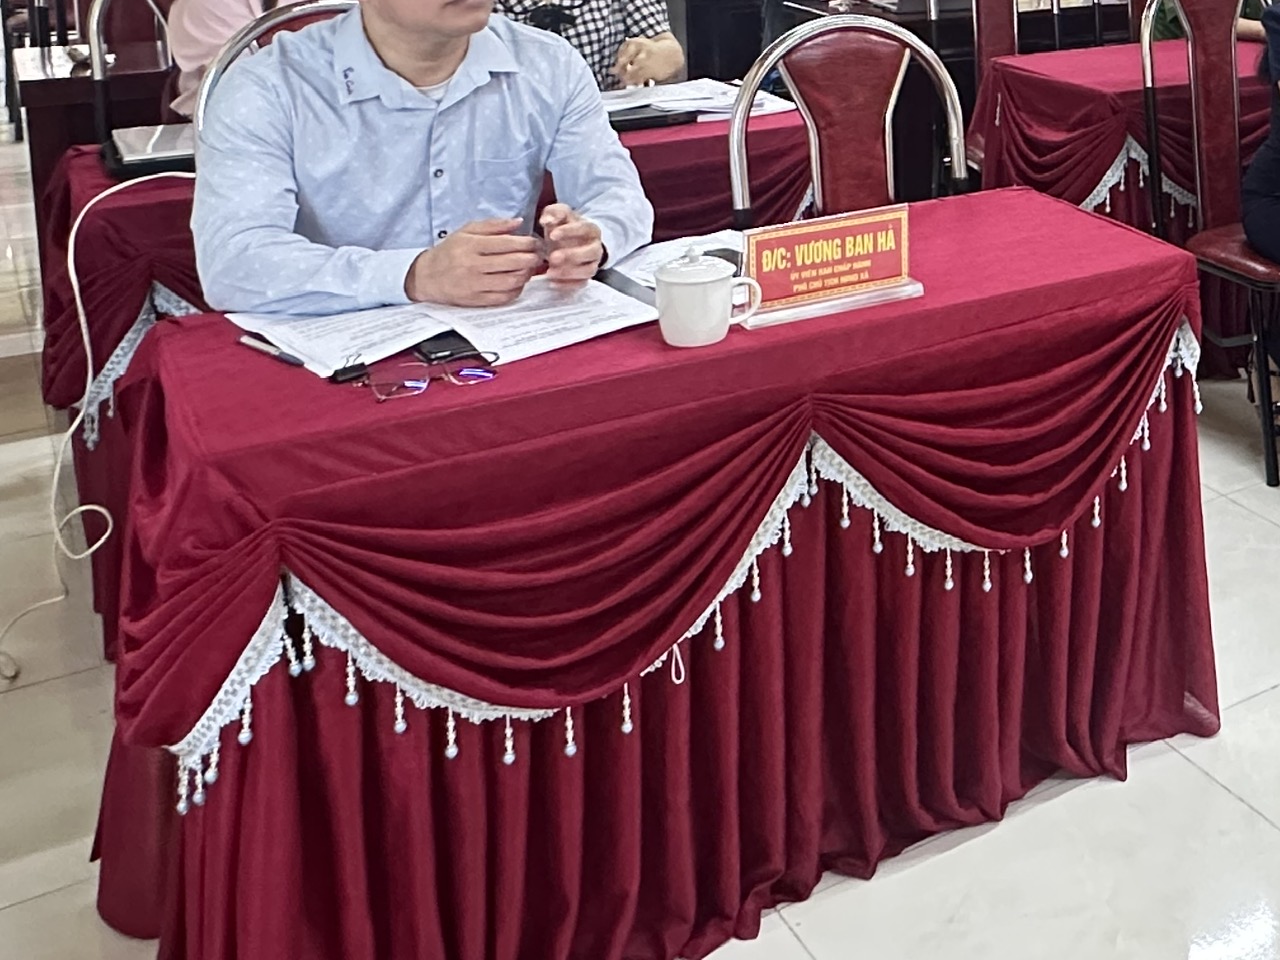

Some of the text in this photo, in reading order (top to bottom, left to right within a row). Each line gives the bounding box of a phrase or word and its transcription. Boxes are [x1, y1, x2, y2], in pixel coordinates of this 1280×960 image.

[762, 247, 791, 272] Đ/C:
[795, 238, 842, 266] VƯƠNG
[845, 232, 873, 258] BAN
